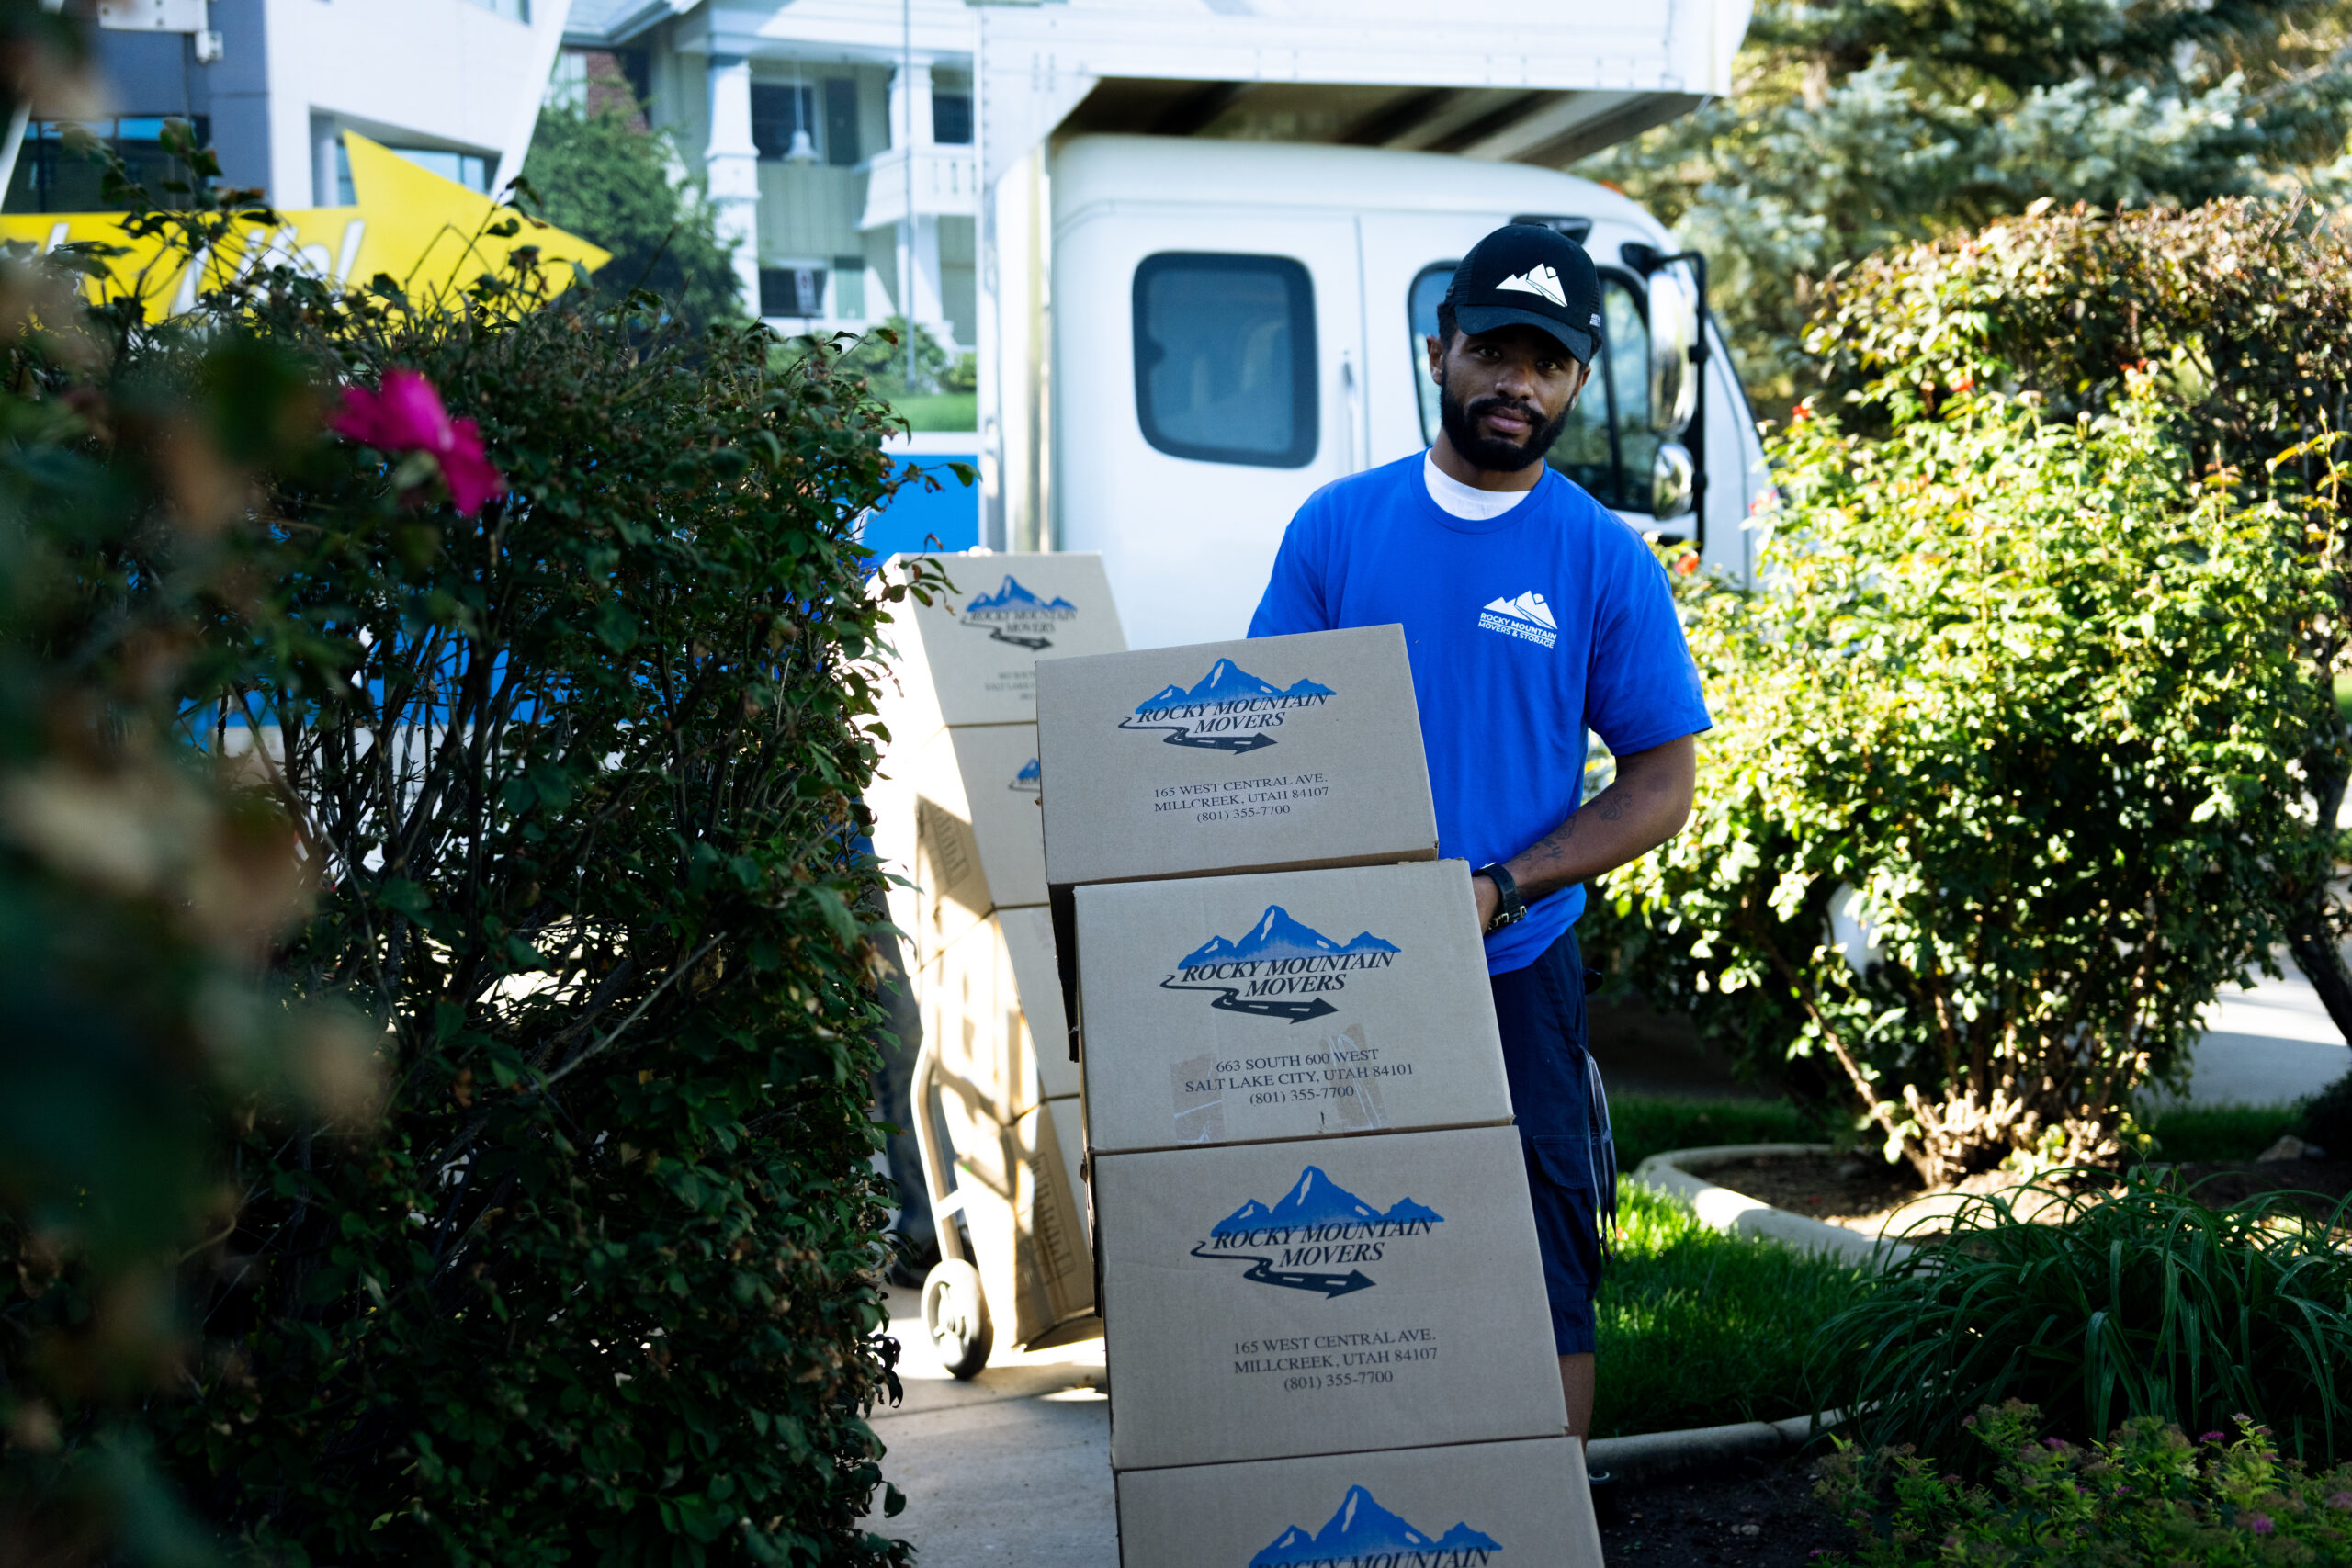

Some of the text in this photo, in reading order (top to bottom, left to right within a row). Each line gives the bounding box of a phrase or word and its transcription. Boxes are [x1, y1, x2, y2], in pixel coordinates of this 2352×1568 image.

[1478, 621, 1510, 635] MOVERS
[1519, 632, 1555, 649] STORAGE
[1480, 612, 1557, 640] ROCKY MOUNTAIN
[1137, 692, 1330, 723] ROCKY MOUNTAIN
[1193, 711, 1286, 734] MOVERS
[1154, 773, 1328, 798] 165 WEST CENTRAL AVE.
[1154, 786, 1329, 812] MILLCREEK, UTAH 84107
[1196, 805, 1291, 823] (801) 355-7700
[1181, 951, 1396, 982] ROCKY MOUNTAIN
[1245, 973, 1347, 997] MOVERS
[1216, 1048, 1379, 1073] 663 SOUTH 600 WEST
[1185, 1063, 1413, 1093] SALT LAKE CITY, UTAH 84101
[1250, 1086, 1354, 1105] (801) 355-7700
[1212, 1216, 1435, 1250] ROCKY MOUNTAIN
[1278, 1242, 1385, 1268] MOVERS
[1234, 1328, 1436, 1354] 165 WEST CENTRAL AVE.
[1234, 1347, 1438, 1374] MILLCREEK, UTAH 84107
[1283, 1371, 1394, 1393] (801) 355-7700
